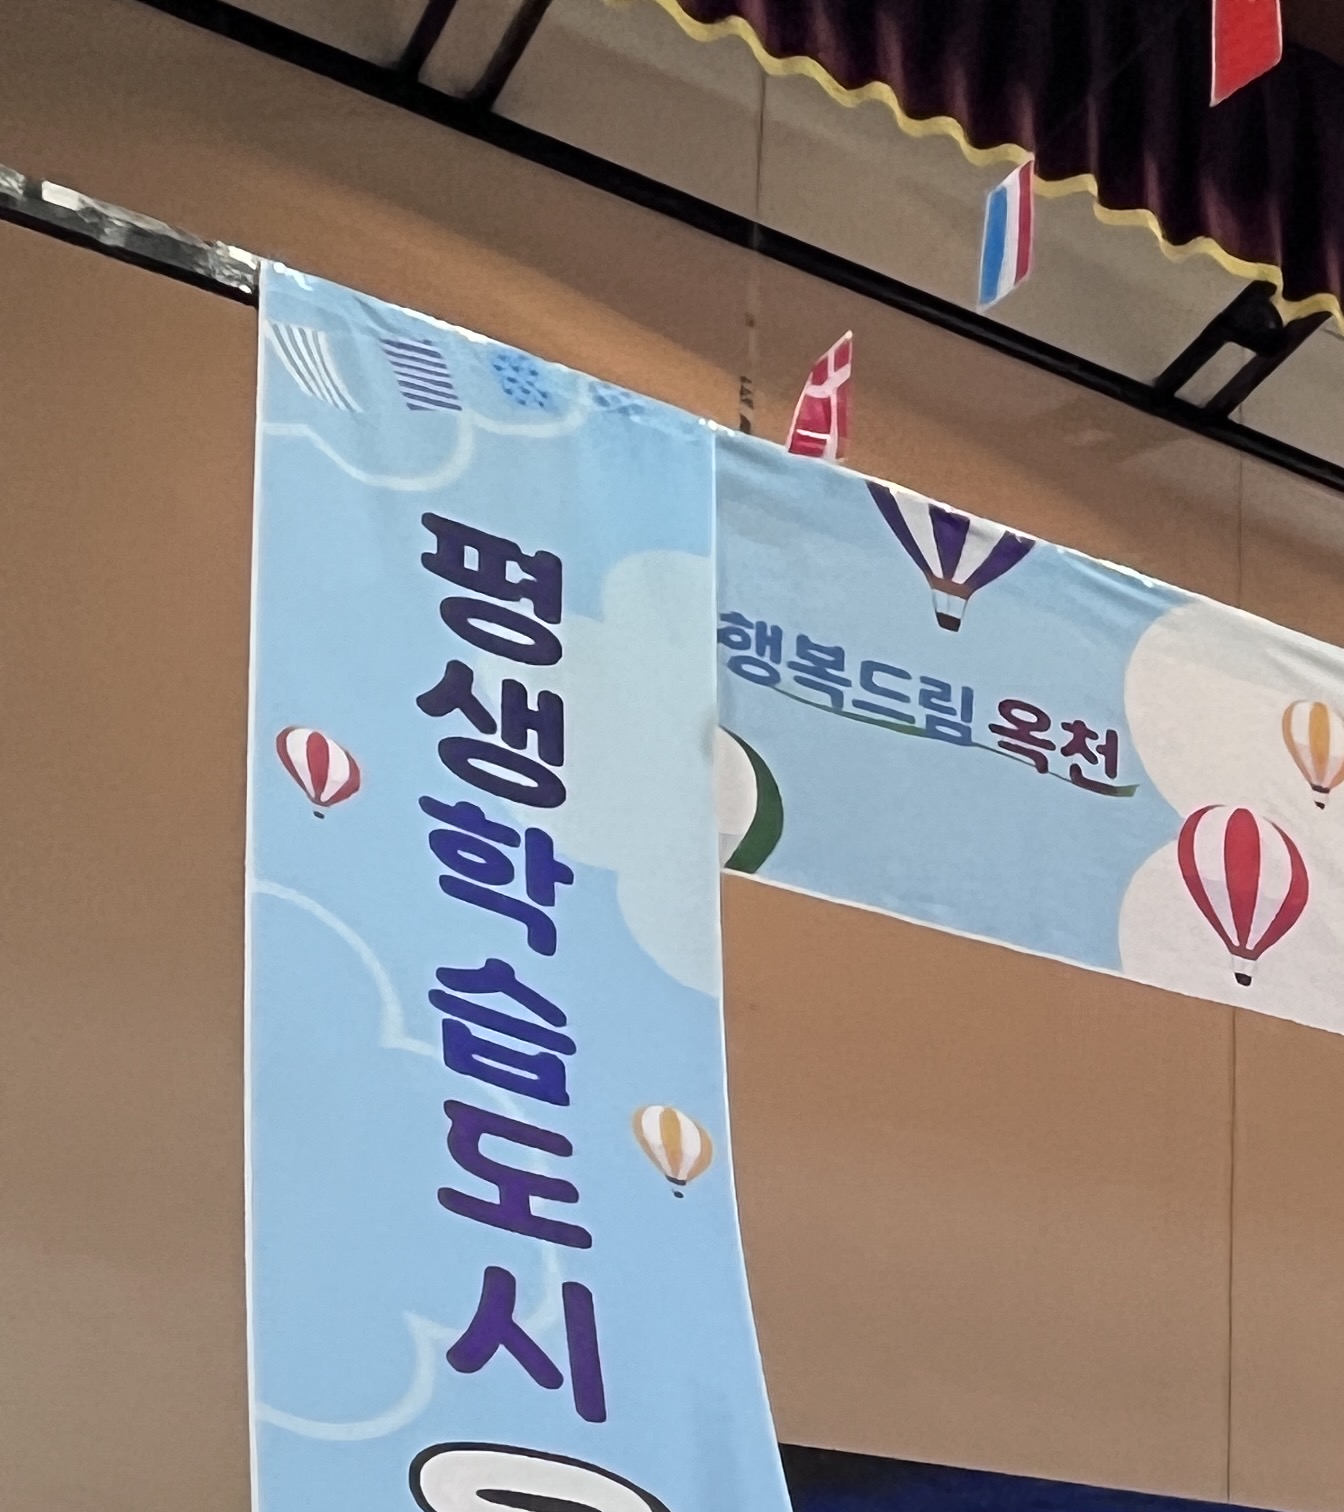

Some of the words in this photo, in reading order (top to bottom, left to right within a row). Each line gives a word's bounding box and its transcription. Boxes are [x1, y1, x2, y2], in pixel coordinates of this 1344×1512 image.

[414, 511, 607, 1424] 평생학습도시
[717, 609, 976, 748] 행복드림
[988, 697, 1121, 791] 옥천
